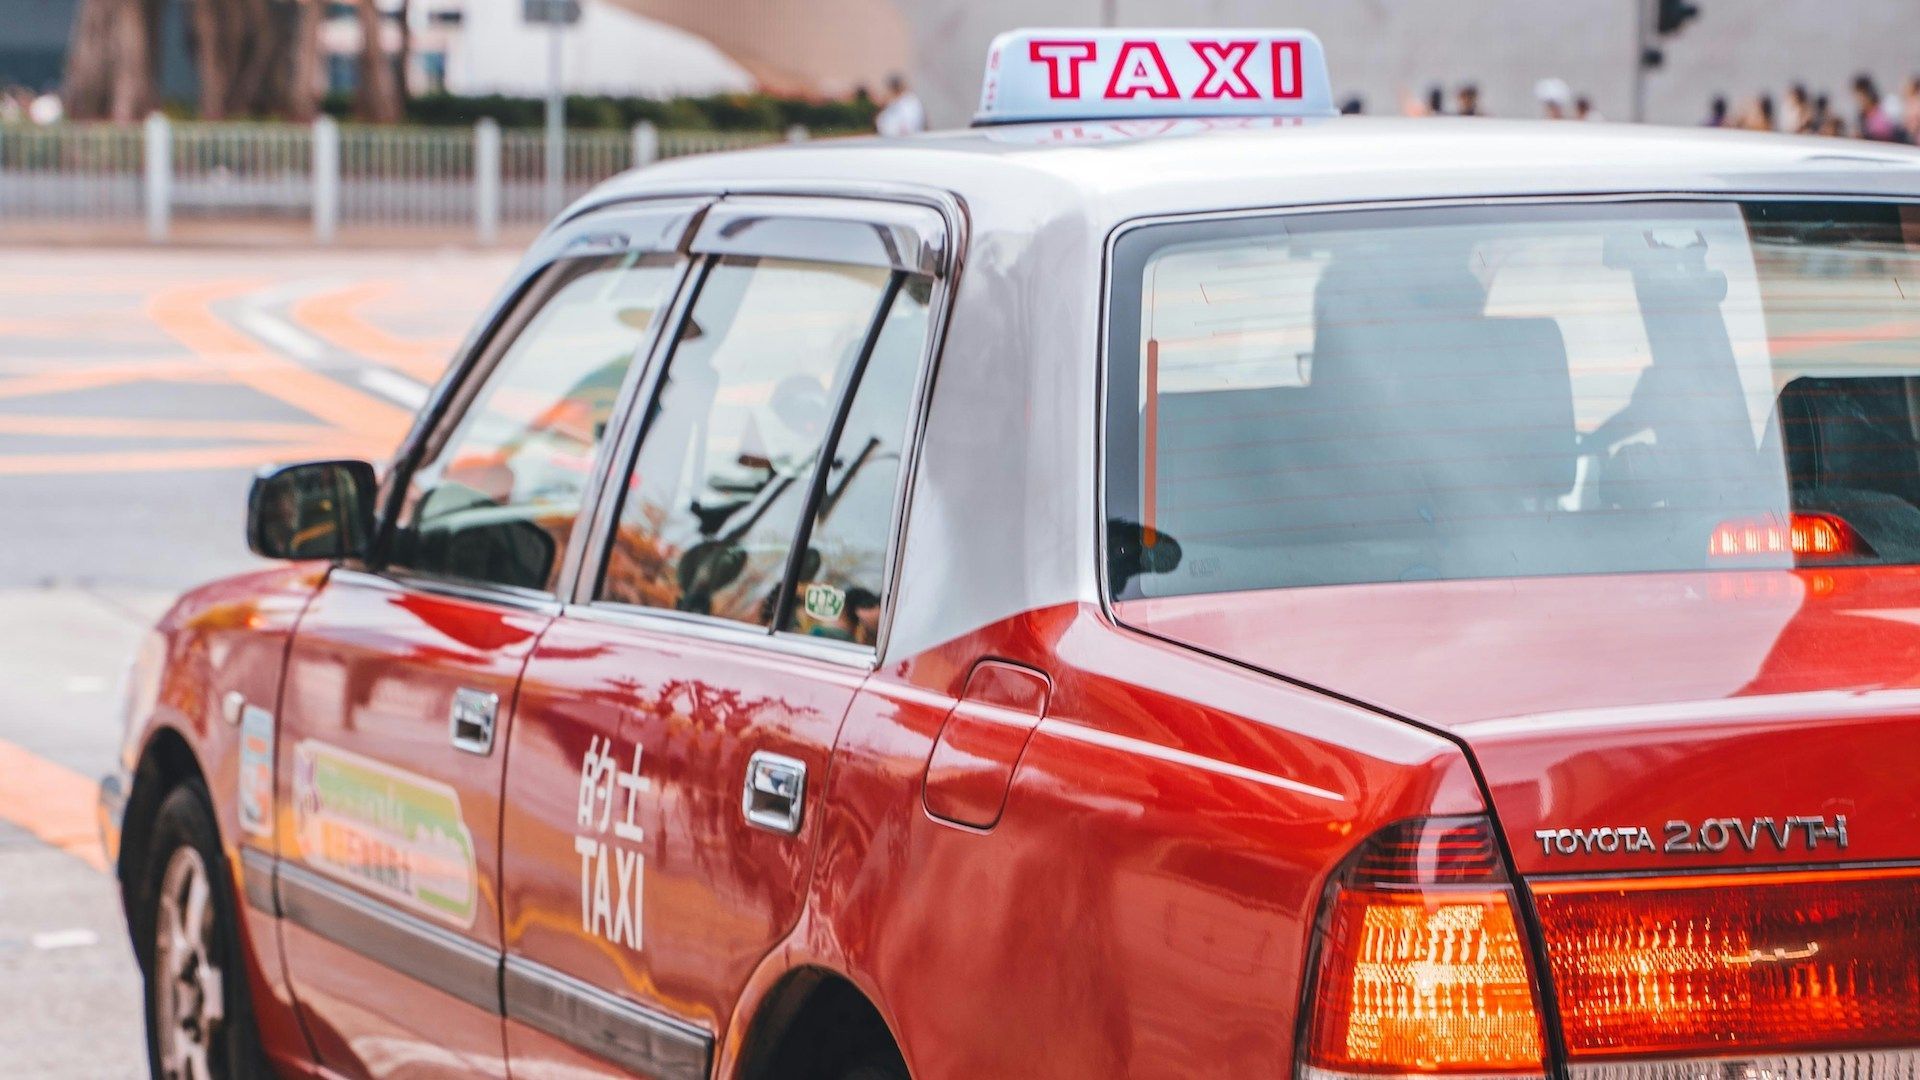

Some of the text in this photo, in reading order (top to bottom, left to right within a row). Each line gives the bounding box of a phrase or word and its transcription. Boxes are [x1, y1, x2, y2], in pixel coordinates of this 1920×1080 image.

[1029, 40, 1304, 99] TAXI
[578, 735, 650, 841] 的士
[1535, 827, 1656, 855] TOYOTA
[576, 837, 643, 951] TAXI
